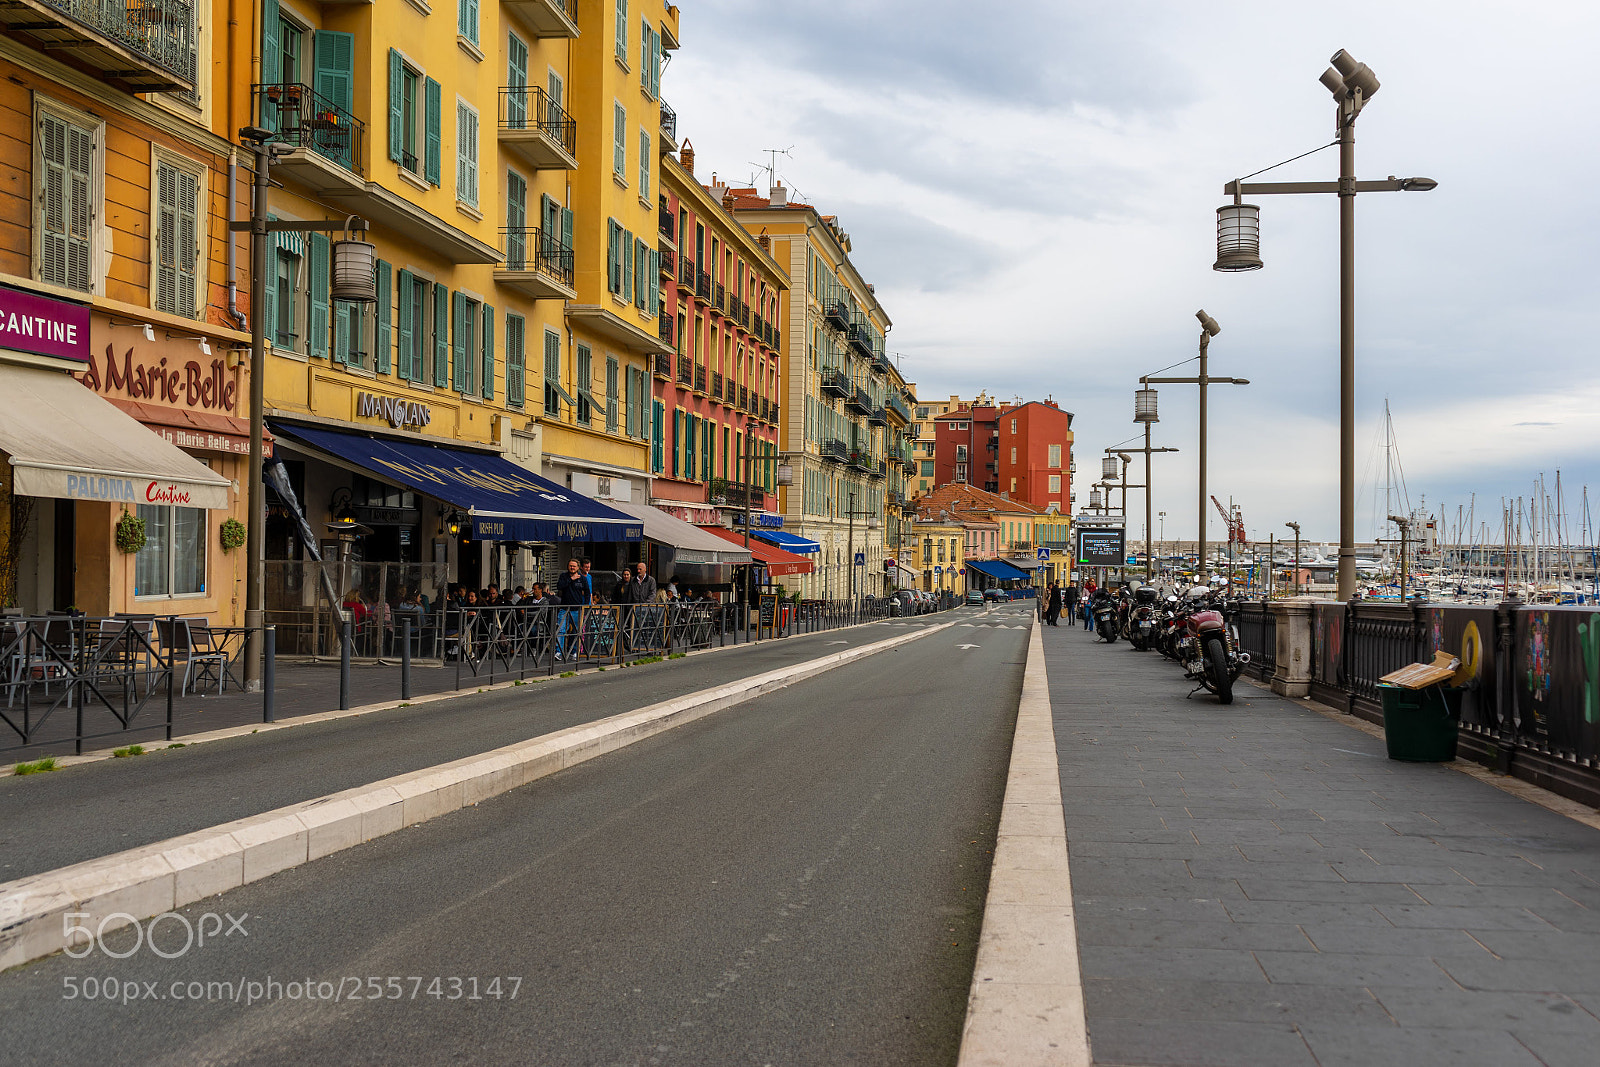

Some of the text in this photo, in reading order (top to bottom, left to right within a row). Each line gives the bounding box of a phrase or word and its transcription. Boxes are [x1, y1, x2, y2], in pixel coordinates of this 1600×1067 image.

[105, 342, 235, 412] Marie-Belle
[177, 430, 205, 447] Marie
[208, 434, 230, 450] Belle
[67, 474, 191, 504] PALOMA Cantine
